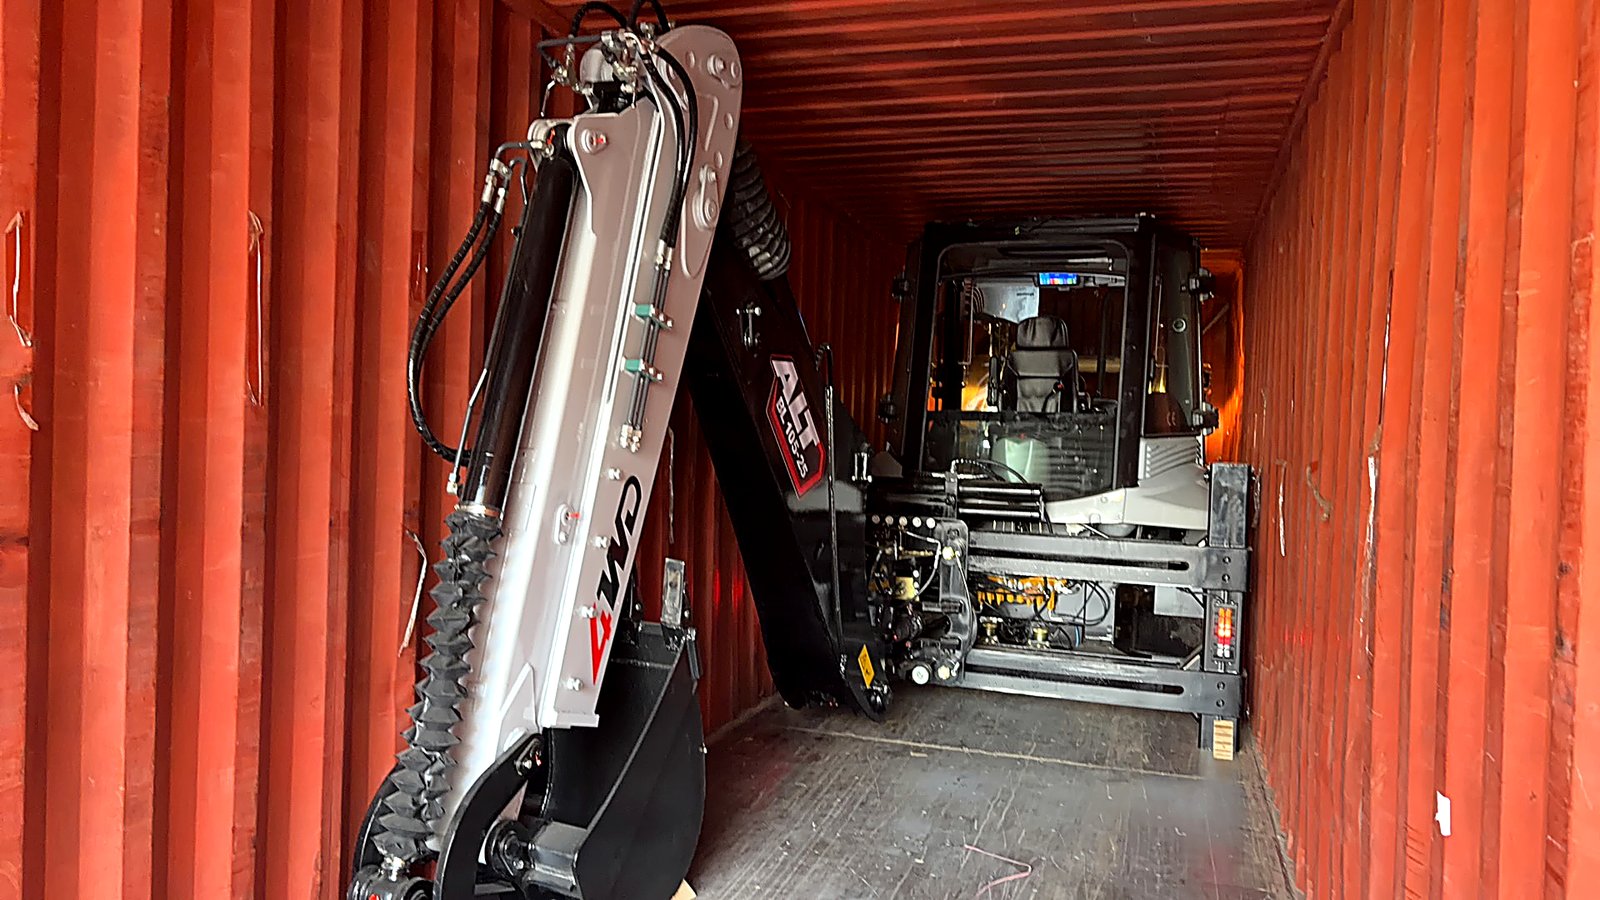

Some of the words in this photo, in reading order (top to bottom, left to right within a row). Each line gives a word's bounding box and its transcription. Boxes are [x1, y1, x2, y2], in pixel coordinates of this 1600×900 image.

[771, 359, 820, 451] ALT
[776, 395, 787, 425] BL
[785, 421, 809, 479] 105-25
[589, 475, 642, 685] 4WD
